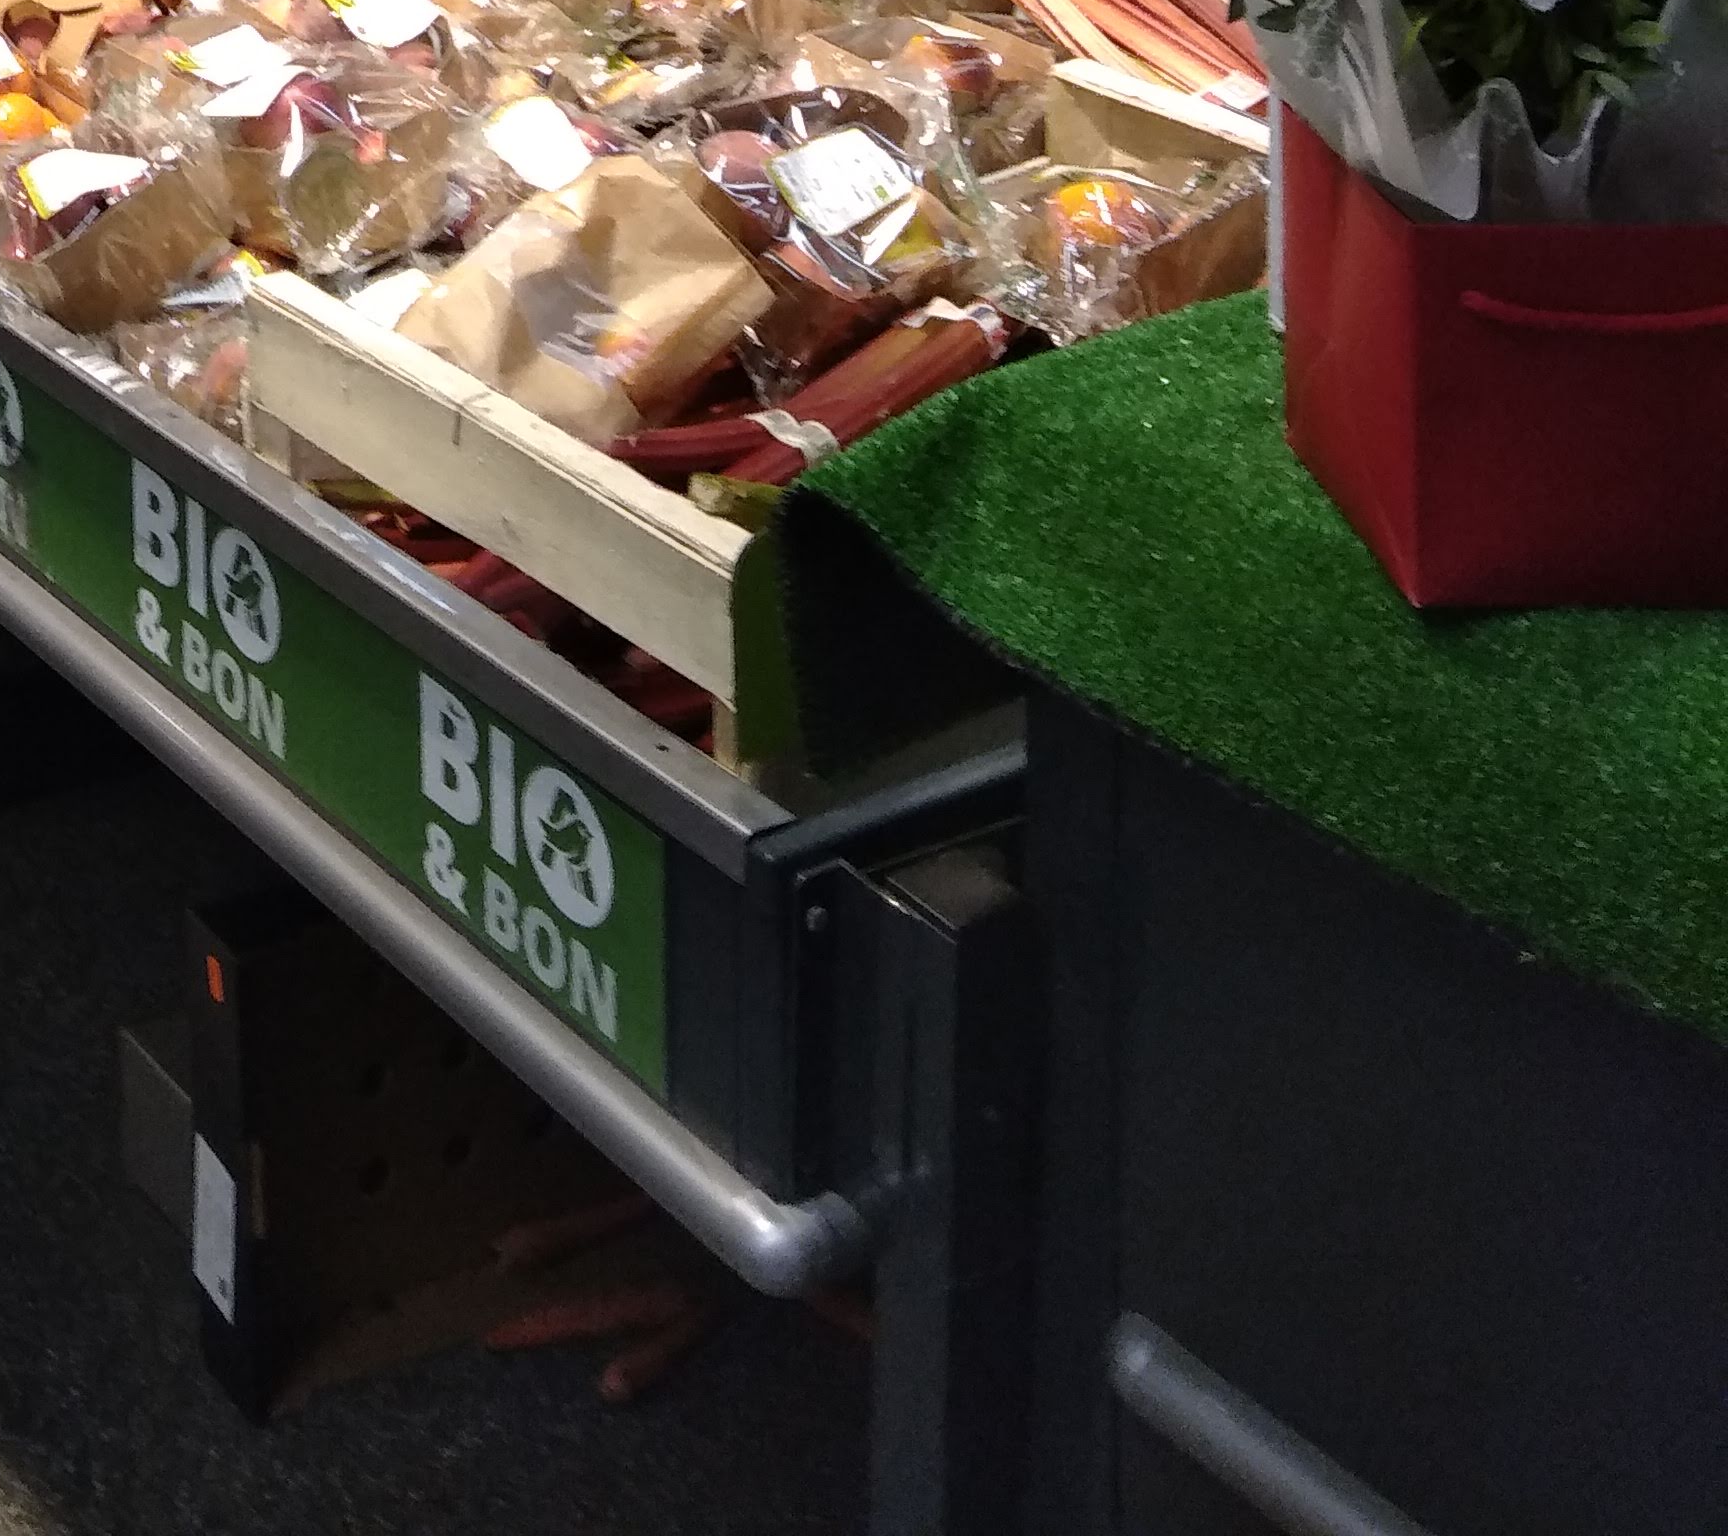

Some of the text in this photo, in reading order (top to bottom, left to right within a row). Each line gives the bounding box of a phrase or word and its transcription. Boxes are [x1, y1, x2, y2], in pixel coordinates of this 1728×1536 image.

[131, 458, 282, 665] BIO
[135, 587, 286, 760] & BON
[419, 672, 615, 929] BIO
[423, 823, 618, 1042] & BON
